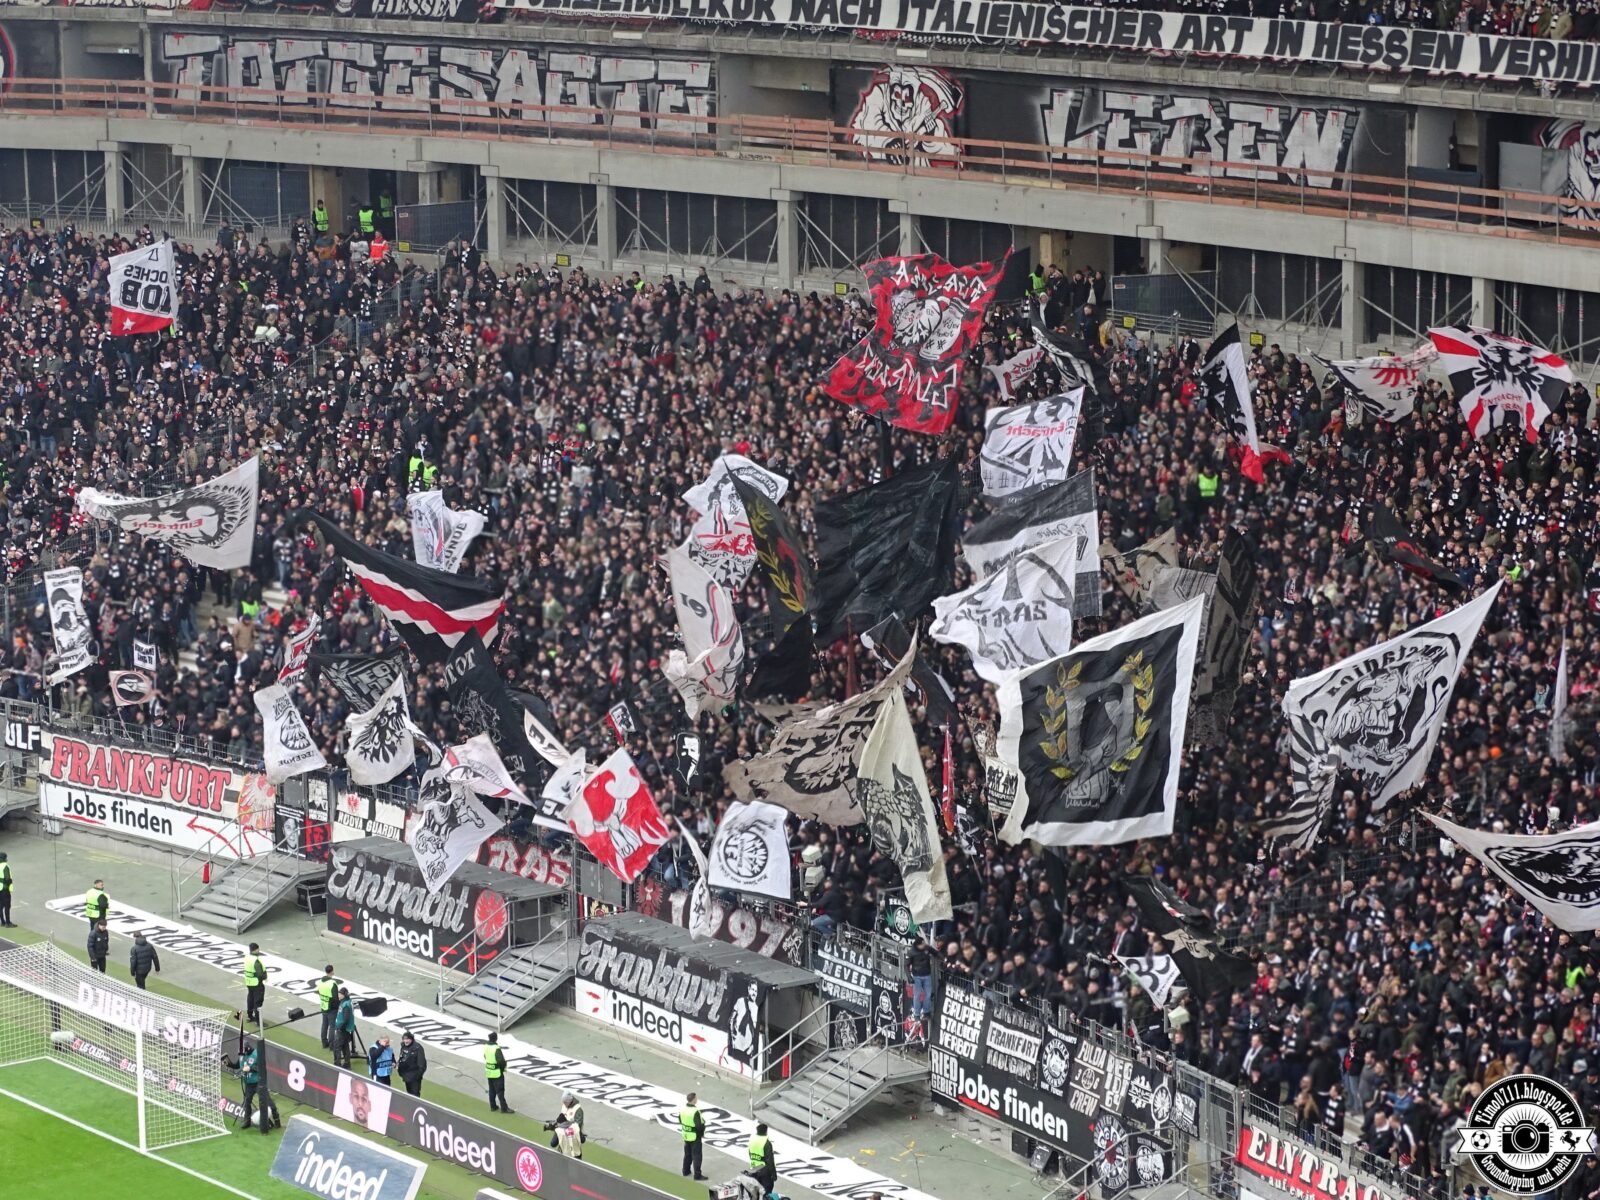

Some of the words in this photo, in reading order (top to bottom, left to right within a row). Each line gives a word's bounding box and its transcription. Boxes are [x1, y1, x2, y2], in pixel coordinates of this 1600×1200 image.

[789, 0, 881, 25] NACH
[898, 1, 1164, 48] ITALIENISCHER
[1175, 14, 1253, 54] ART
[1263, 20, 1304, 57] IN
[1312, 24, 1464, 72] HESSEN
[163, 31, 713, 133] TOTGESAGTE
[1043, 89, 1350, 188] LEBEN
[50, 737, 231, 812] FRANKFURT
[64, 792, 106, 821] Jobs
[112, 799, 173, 836] finden
[366, 820, 400, 840] GUARDIA
[327, 847, 469, 933] Eintracht
[362, 909, 434, 959] indeed
[576, 923, 728, 1023] Frankfurt
[822, 959, 867, 987] NEVER
[824, 940, 873, 970] ULTRAS
[78, 982, 159, 1036] DJIBRIL
[611, 990, 683, 1044] indeed
[940, 1014, 980, 1043] STADION
[943, 997, 984, 1029] GRUPPE
[939, 1029, 978, 1060] VERBOT
[990, 1027, 1039, 1059] FRANKFURT
[1077, 1040, 1107, 1069] FULDA
[287, 1059, 306, 1092] 8
[931, 1048, 958, 1082] RIED
[931, 1073, 958, 1099] GEBIET
[958, 1067, 1000, 1111] Jobs
[1004, 1086, 1068, 1142] finden
[1070, 1089, 1098, 1117] CREW
[417, 1113, 496, 1175] indeed
[294, 1140, 388, 1200] indeed
